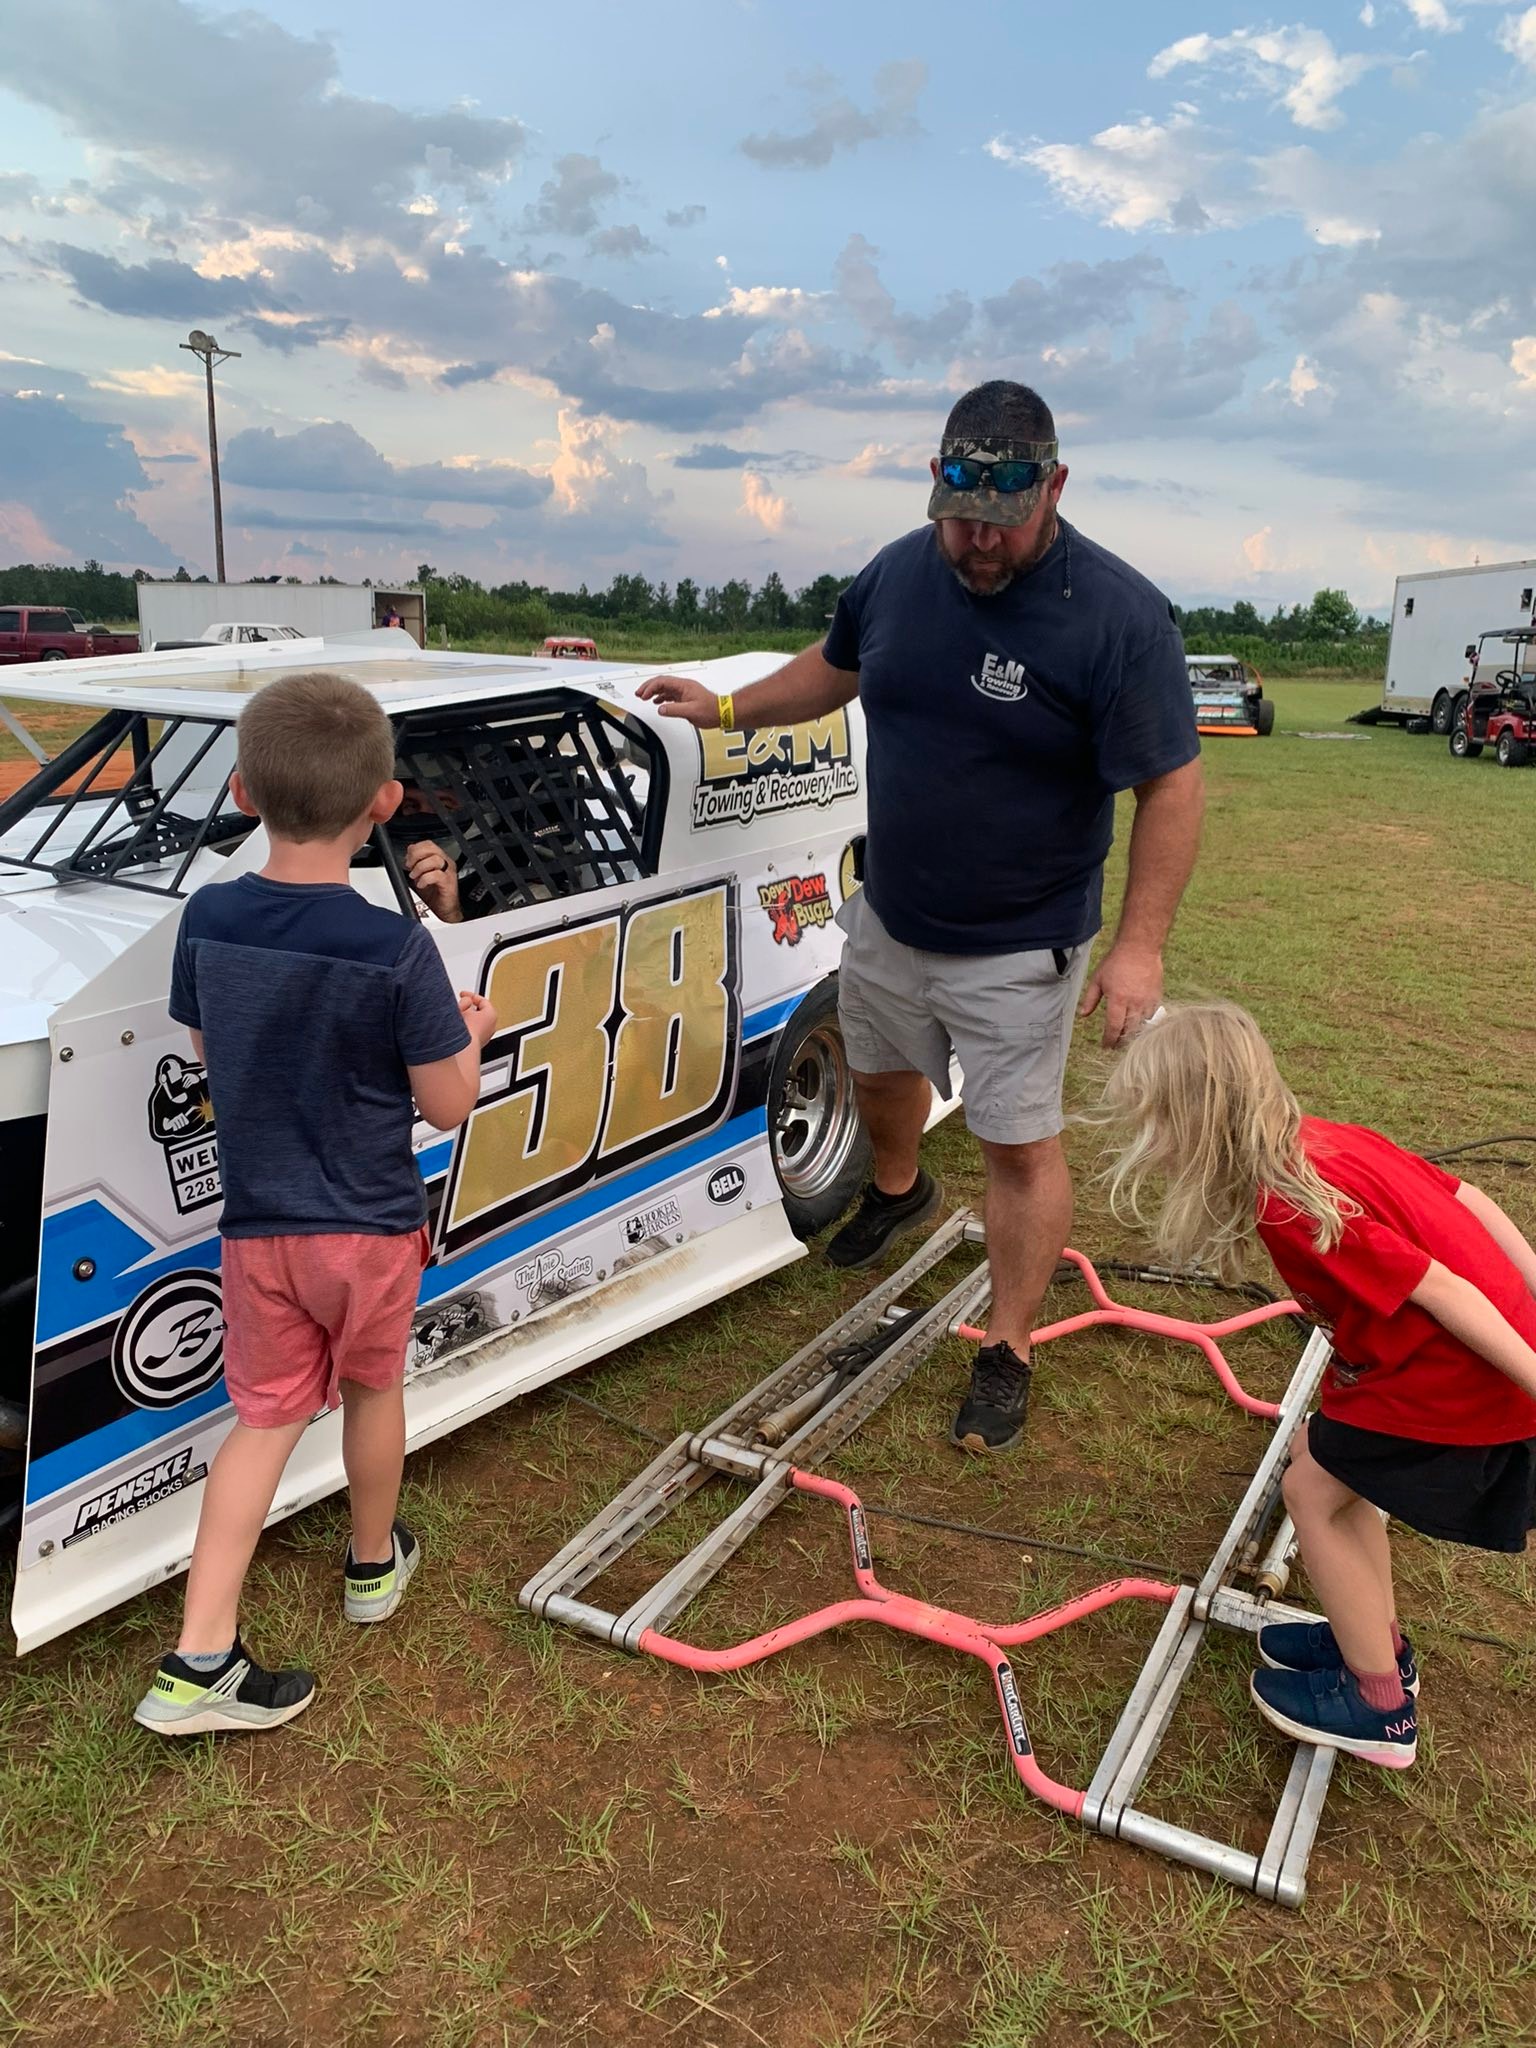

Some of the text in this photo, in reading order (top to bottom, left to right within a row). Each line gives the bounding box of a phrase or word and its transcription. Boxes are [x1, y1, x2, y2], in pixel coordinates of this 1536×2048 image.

[982, 653, 1025, 684] E&M
[981, 673, 1021, 694] Towing
[986, 683, 1018, 698] Recovery
[700, 706, 849, 780] E&M
[698, 787, 753, 817] Towing
[756, 780, 767, 804] &
[835, 767, 856, 788] Inc.
[790, 875, 826, 901] Dew
[793, 900, 832, 927] Bugz
[446, 885, 728, 1234] 38
[711, 1170, 743, 1199] BELL
[640, 1200, 678, 1226] HOOKER
[644, 1214, 681, 1237] HARNESS
[518, 1269, 535, 1285] The
[557, 1259, 590, 1292] Seating
[76, 1450, 189, 1530] PENSKE
[91, 1477, 183, 1536] RACING SHOCKS
[350, 1580, 381, 1593] PUMA
